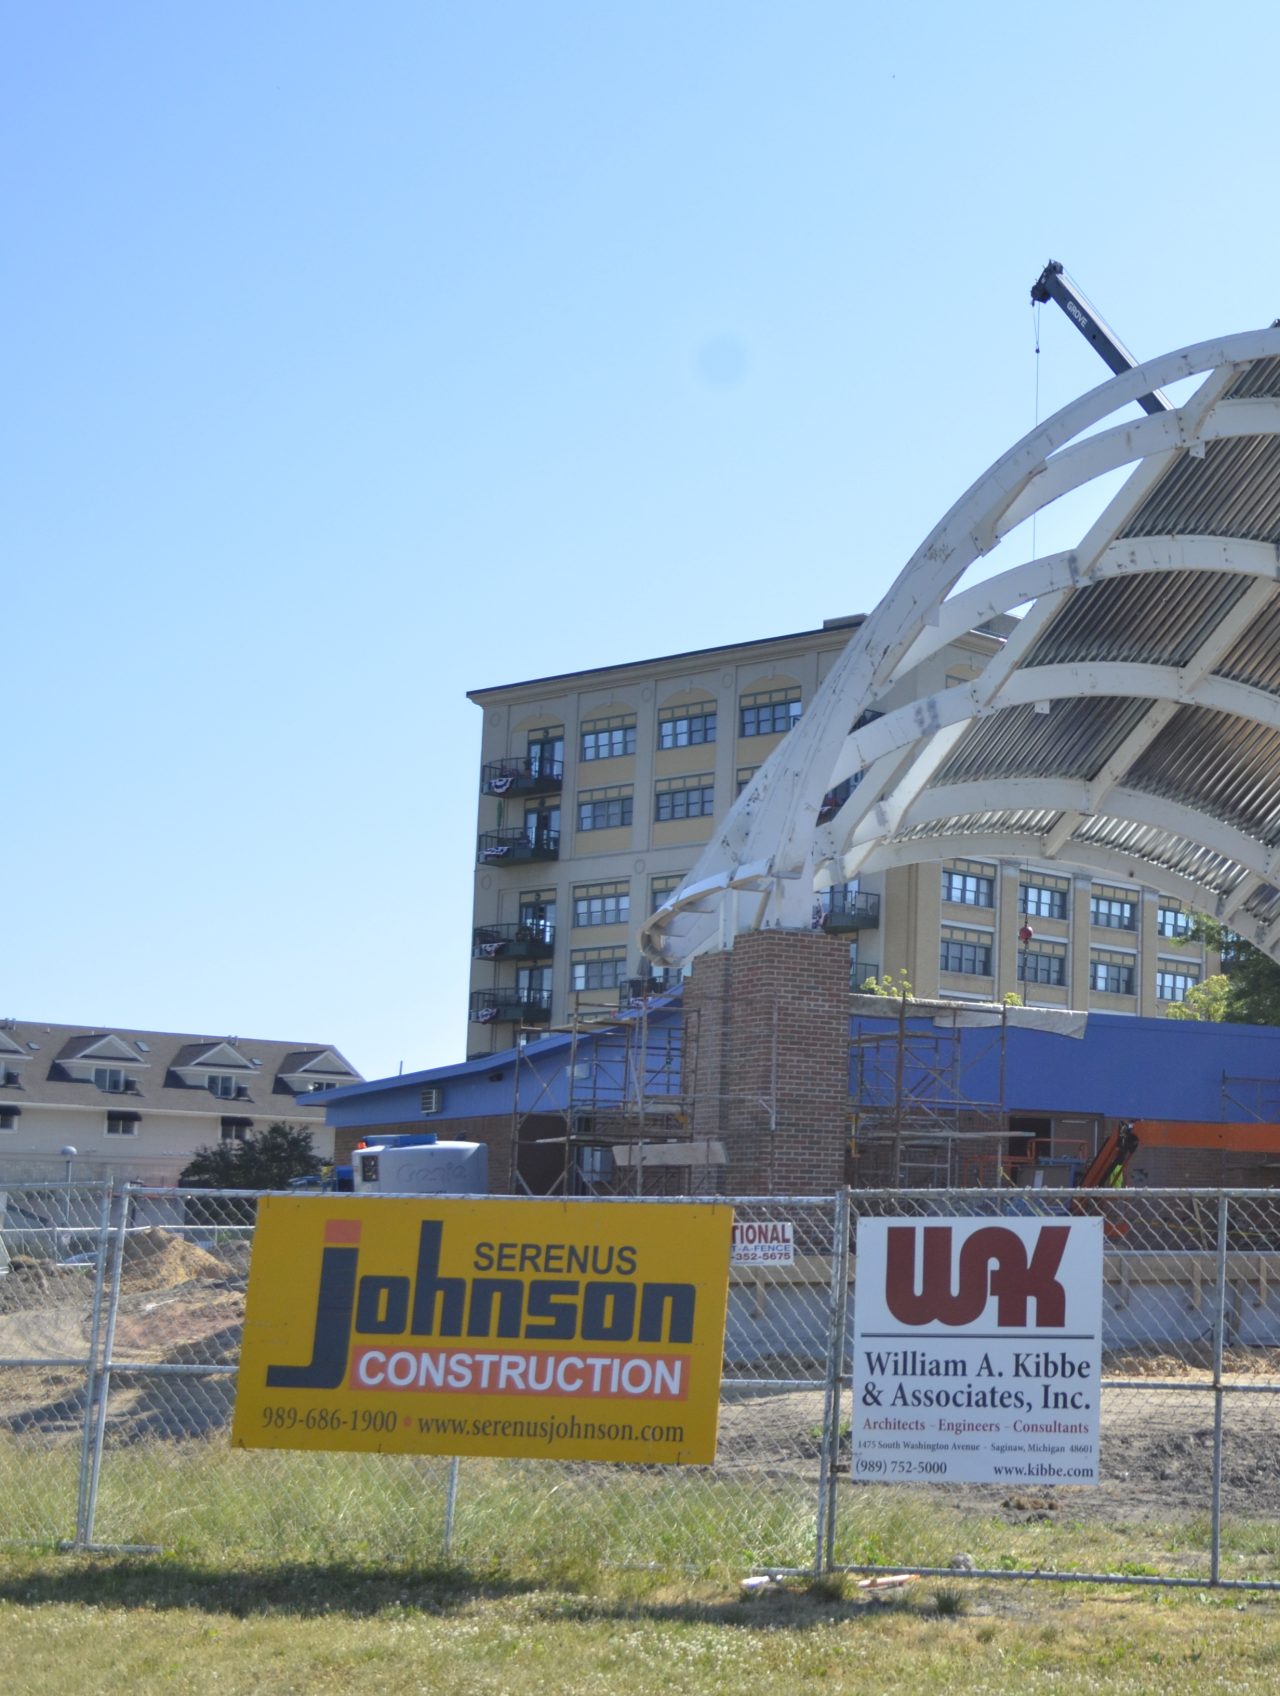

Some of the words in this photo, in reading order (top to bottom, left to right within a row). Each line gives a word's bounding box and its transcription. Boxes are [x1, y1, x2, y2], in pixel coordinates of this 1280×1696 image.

[1066, 300, 1088, 328] GROVE
[732, 1224, 790, 1244] TIONAL
[473, 1242, 637, 1275] SERENUS
[358, 1350, 682, 1394] CONSTRUCTION
[865, 1351, 967, 1376] William
[976, 1354, 1003, 1377] A.
[1013, 1353, 1091, 1378] Kibbe
[862, 1382, 882, 1406] &
[891, 1383, 1033, 1412] Associates,
[1041, 1384, 1091, 1409] Inc.
[262, 1407, 397, 1433] 989-686-1900
[418, 1416, 685, 1445] www.serenusjohnson.com
[863, 1417, 926, 1431] Architects
[938, 1419, 1001, 1435] Engineers
[1013, 1420, 1089, 1434] Consultants
[878, 1441, 901, 1449] South
[903, 1441, 949, 1451] Washington
[991, 1443, 1026, 1453] Saginaw,
[1027, 1443, 1065, 1454] Michigan
[1070, 1445, 1093, 1453] 48601
[856, 1460, 887, 1474] (989)
[891, 1461, 947, 1474] 752-5000
[993, 1463, 1093, 1478] www.kibbe.com
